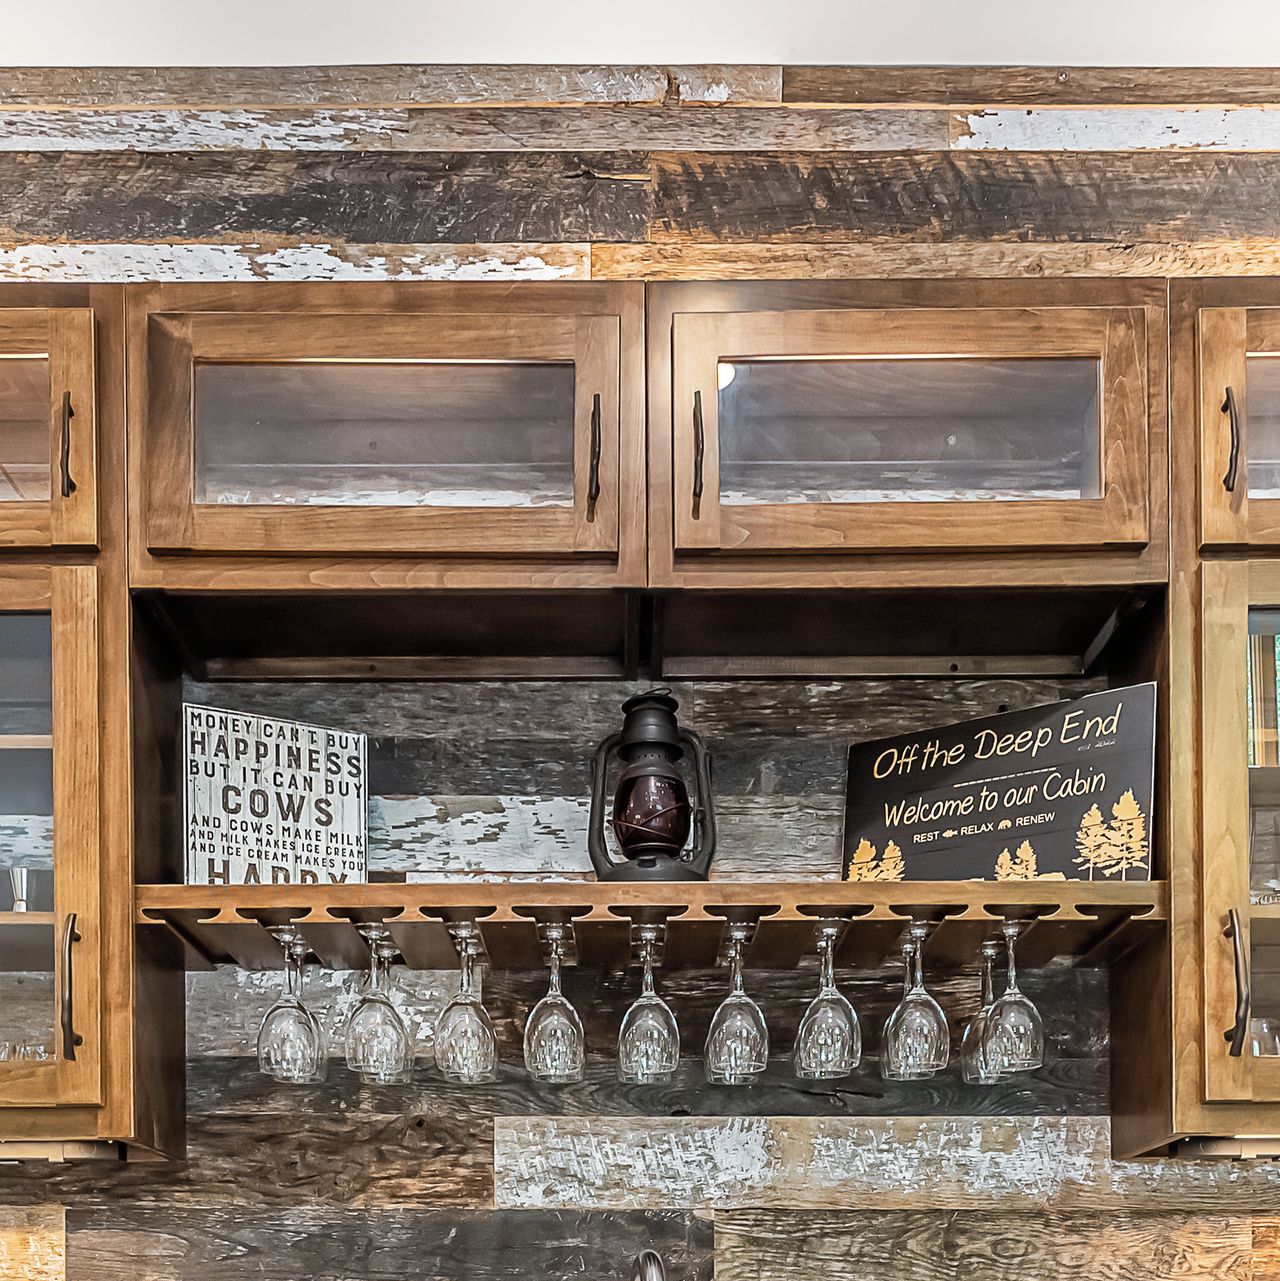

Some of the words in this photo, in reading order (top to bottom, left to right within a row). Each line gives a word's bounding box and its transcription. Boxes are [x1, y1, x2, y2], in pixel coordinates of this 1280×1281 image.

[190, 711, 253, 736] MONEY
[263, 723, 318, 745] CAN'T
[326, 733, 361, 752] BUY
[873, 743, 920, 779] Off
[921, 739, 966, 771] the
[974, 727, 1053, 758] Deep
[1060, 702, 1123, 744] End
[190, 730, 362, 779] HAPPINESS
[189, 758, 231, 780] BUT
[242, 766, 262, 785] IT
[272, 771, 313, 793] CAN
[324, 778, 363, 799] BUY
[884, 795, 975, 828] Welcome
[978, 785, 999, 812] to
[1003, 784, 1039, 808] our
[1042, 766, 1107, 801] Cabin
[221, 784, 334, 827] COWS
[189, 828, 214, 841] AND
[220, 832, 249, 845] MILK
[255, 836, 296, 851] MAKES
[301, 842, 320, 854] ICE
[325, 845, 364, 859] CREAM
[190, 813, 221, 829] AND
[229, 818, 274, 836] COWS
[281, 825, 322, 842] MAKE
[329, 831, 363, 847] MILK
[913, 830, 941, 844] REST
[960, 822, 995, 836] RELAX
[1015, 811, 1056, 827] RENEW
[190, 841, 216, 854] AND
[221, 845, 242, 857] ICE
[247, 848, 289, 862] CREAM
[294, 853, 336, 868] MAKES
[341, 859, 364, 872] YOU
